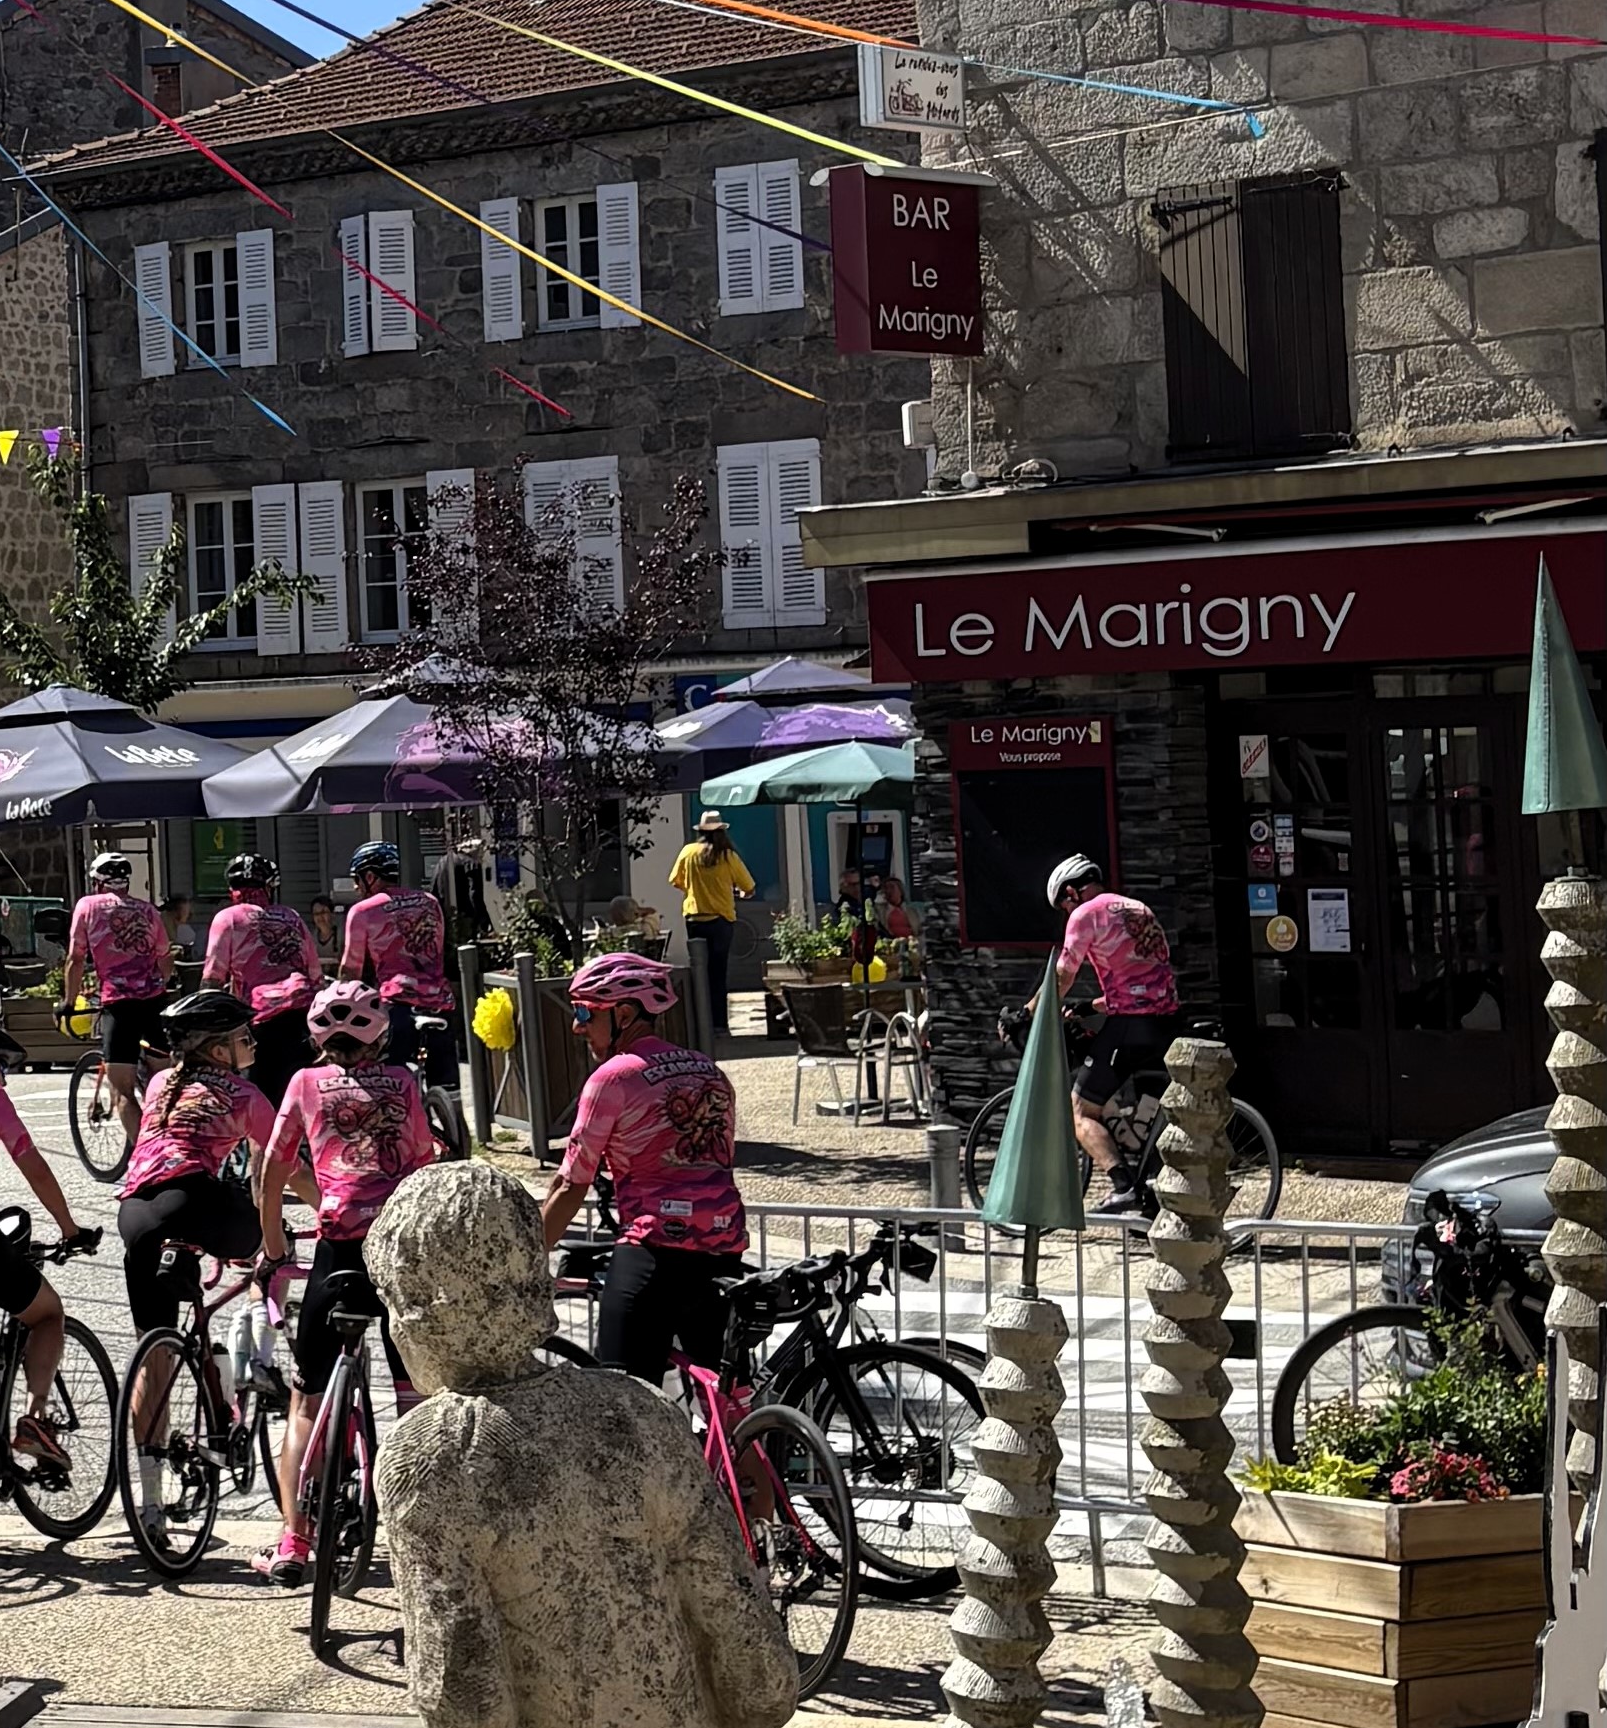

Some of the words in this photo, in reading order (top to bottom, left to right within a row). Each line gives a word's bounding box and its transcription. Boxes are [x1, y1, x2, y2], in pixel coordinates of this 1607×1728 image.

[893, 194, 950, 231] BAR
[911, 260, 938, 288] Le
[879, 303, 974, 341] Marigny
[915, 603, 994, 657] Le
[1025, 583, 1356, 657] Marigny
[971, 726, 994, 743] Le
[1001, 723, 1087, 745] Marigny
[999, 752, 1022, 762] Vous
[1023, 752, 1061, 763] propose
[713, 1215, 732, 1229] SLP
